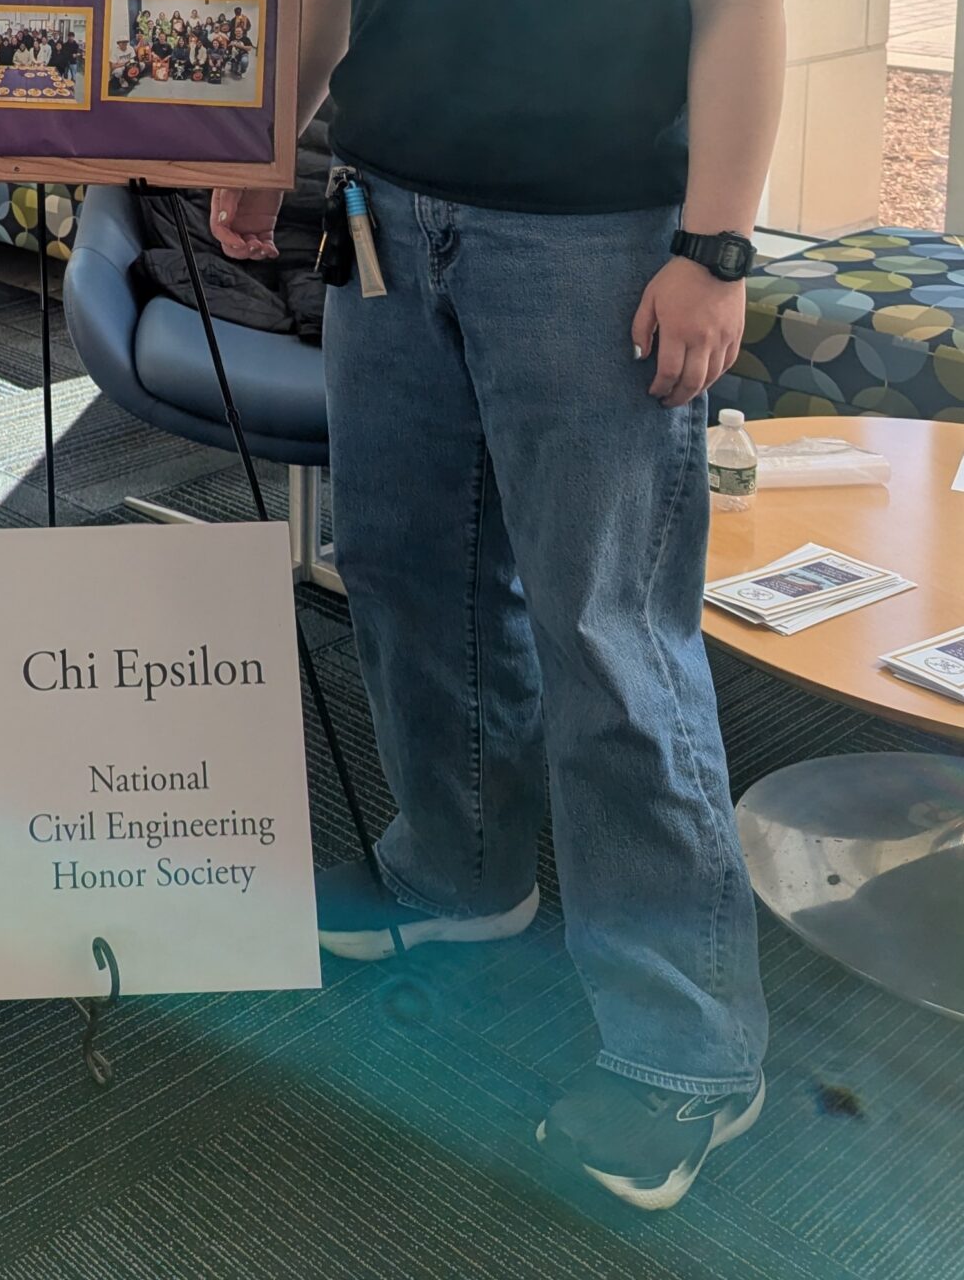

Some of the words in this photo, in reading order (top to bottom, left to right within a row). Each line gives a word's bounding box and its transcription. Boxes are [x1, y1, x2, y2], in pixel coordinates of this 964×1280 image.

[23, 648, 99, 692] Chi
[114, 644, 266, 702] Epsilon
[88, 760, 210, 793] National
[28, 811, 96, 843] Civil
[106, 809, 276, 849] Engineering
[52, 860, 147, 890] Honor
[156, 858, 256, 893] Society
